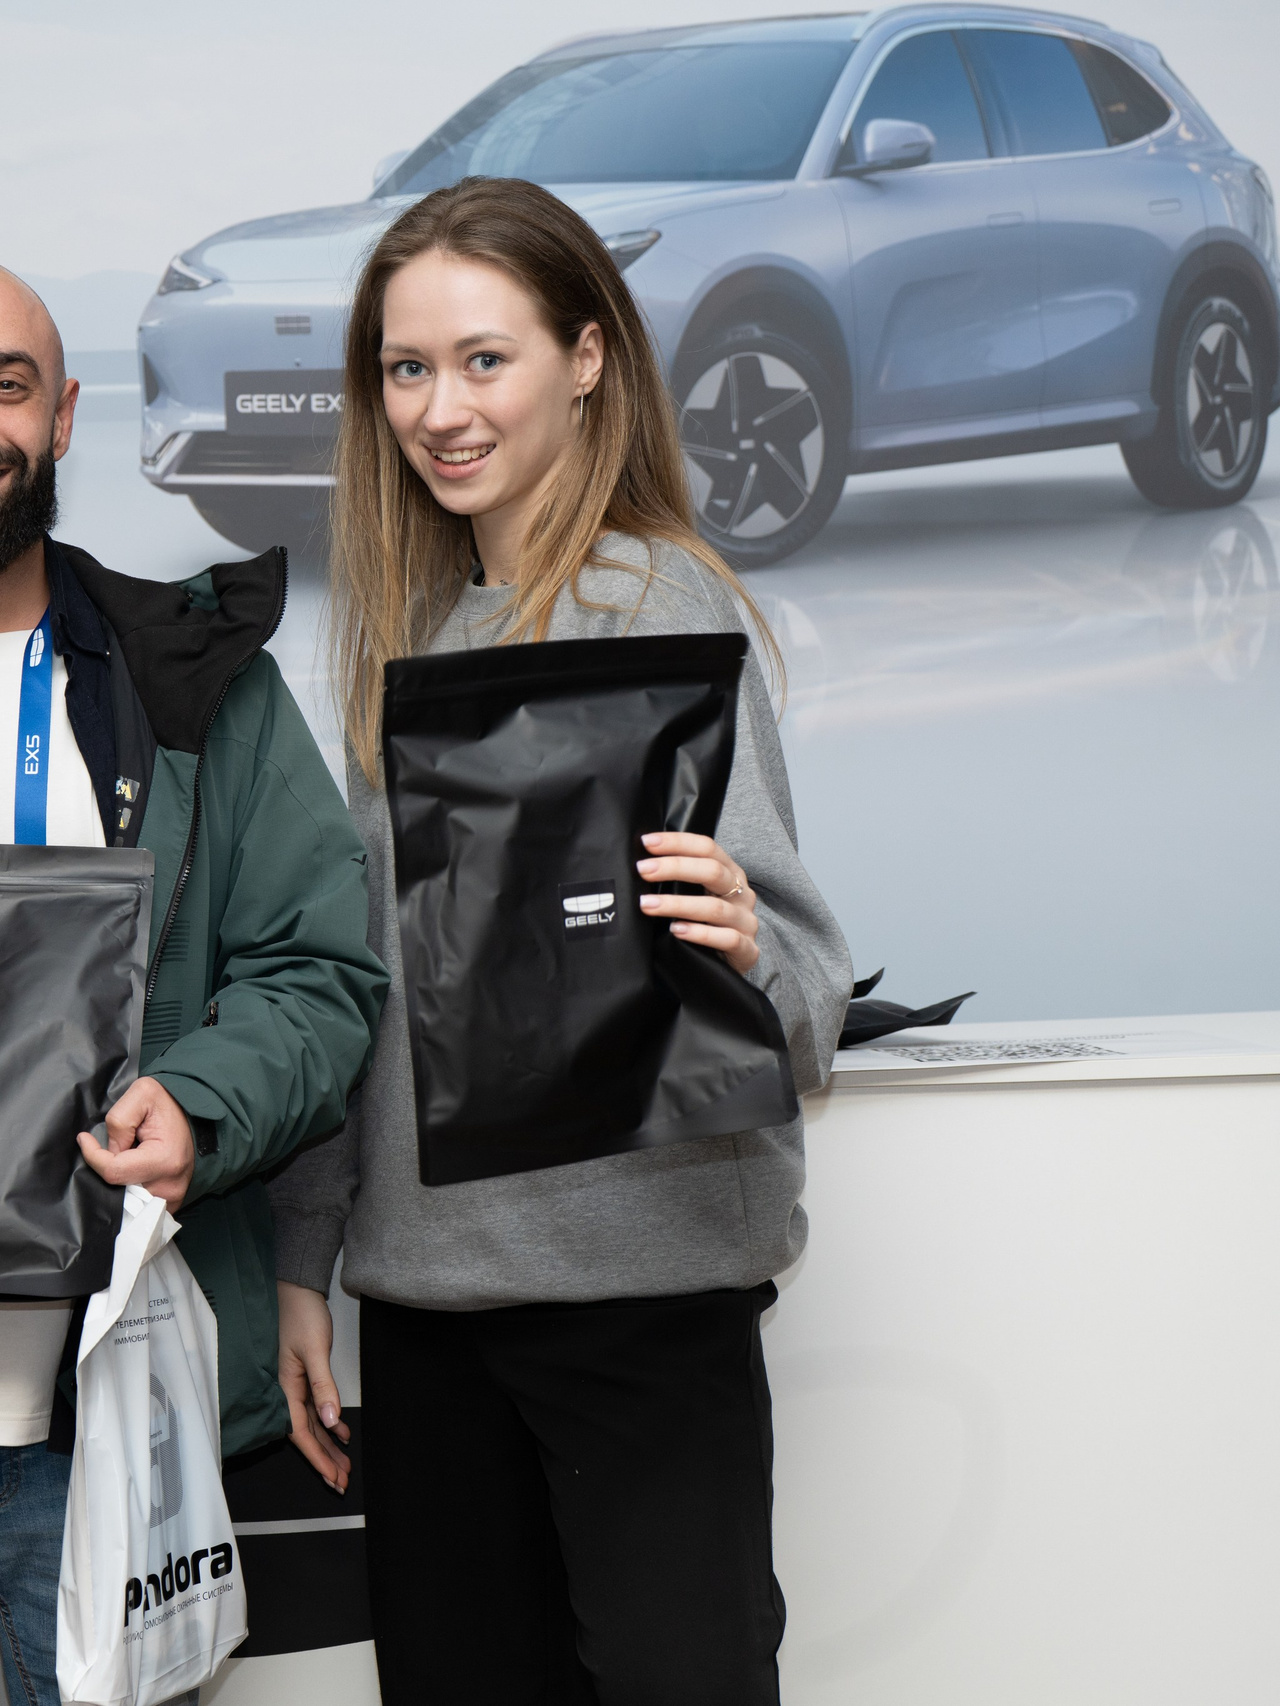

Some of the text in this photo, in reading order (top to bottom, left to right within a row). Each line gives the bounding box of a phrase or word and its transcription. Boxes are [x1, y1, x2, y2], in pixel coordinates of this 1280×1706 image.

[236, 393, 345, 413] GEELY EX
[24, 734, 40, 775] EX5
[564, 911, 616, 928] GEELY
[202, 1582, 233, 1601] СИСТЕМЫ
